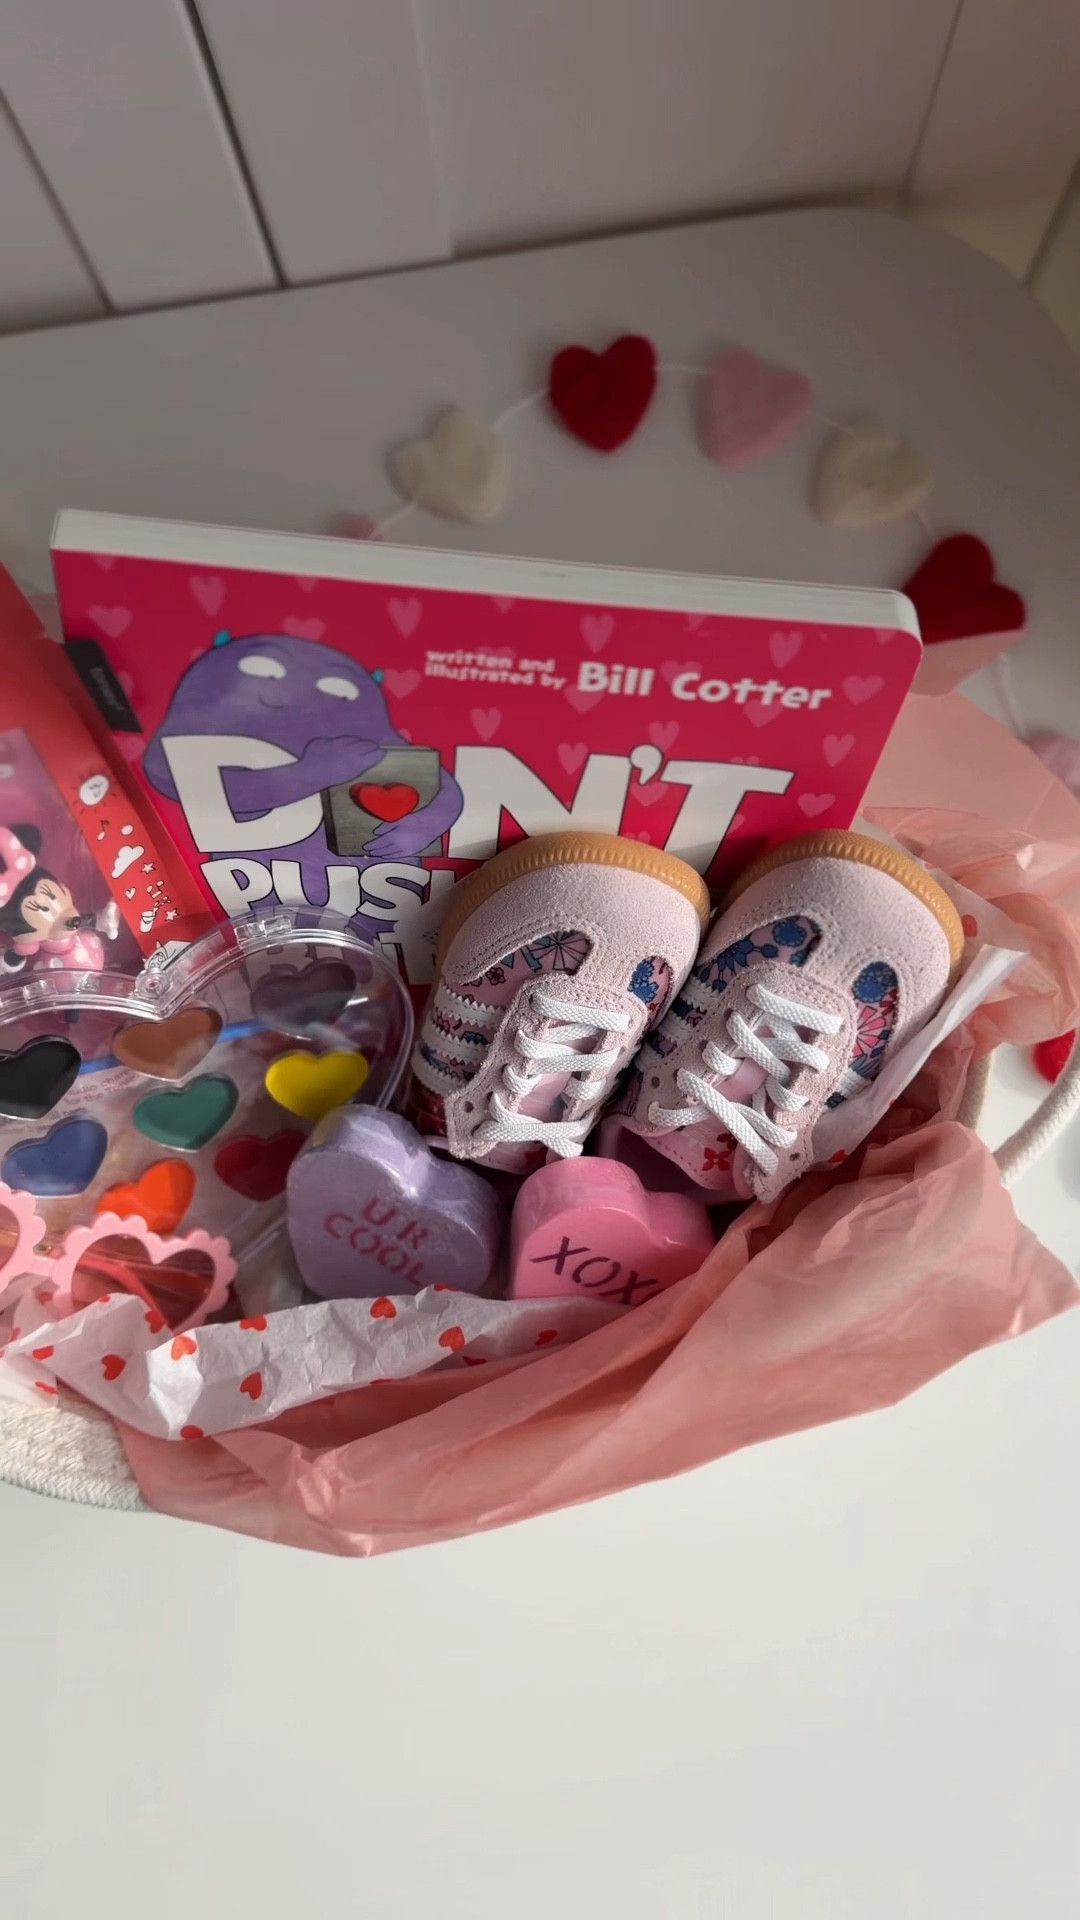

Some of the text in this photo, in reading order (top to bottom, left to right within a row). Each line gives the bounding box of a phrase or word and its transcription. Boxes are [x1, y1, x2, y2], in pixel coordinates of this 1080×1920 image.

[424, 662, 567, 690] illustrated by
[425, 649, 556, 673] written and
[577, 660, 832, 710] Bill Cotter
[160, 734, 796, 876] DN'T
[323, 1211, 425, 1287] COOL
[362, 1197, 430, 1251] U R
